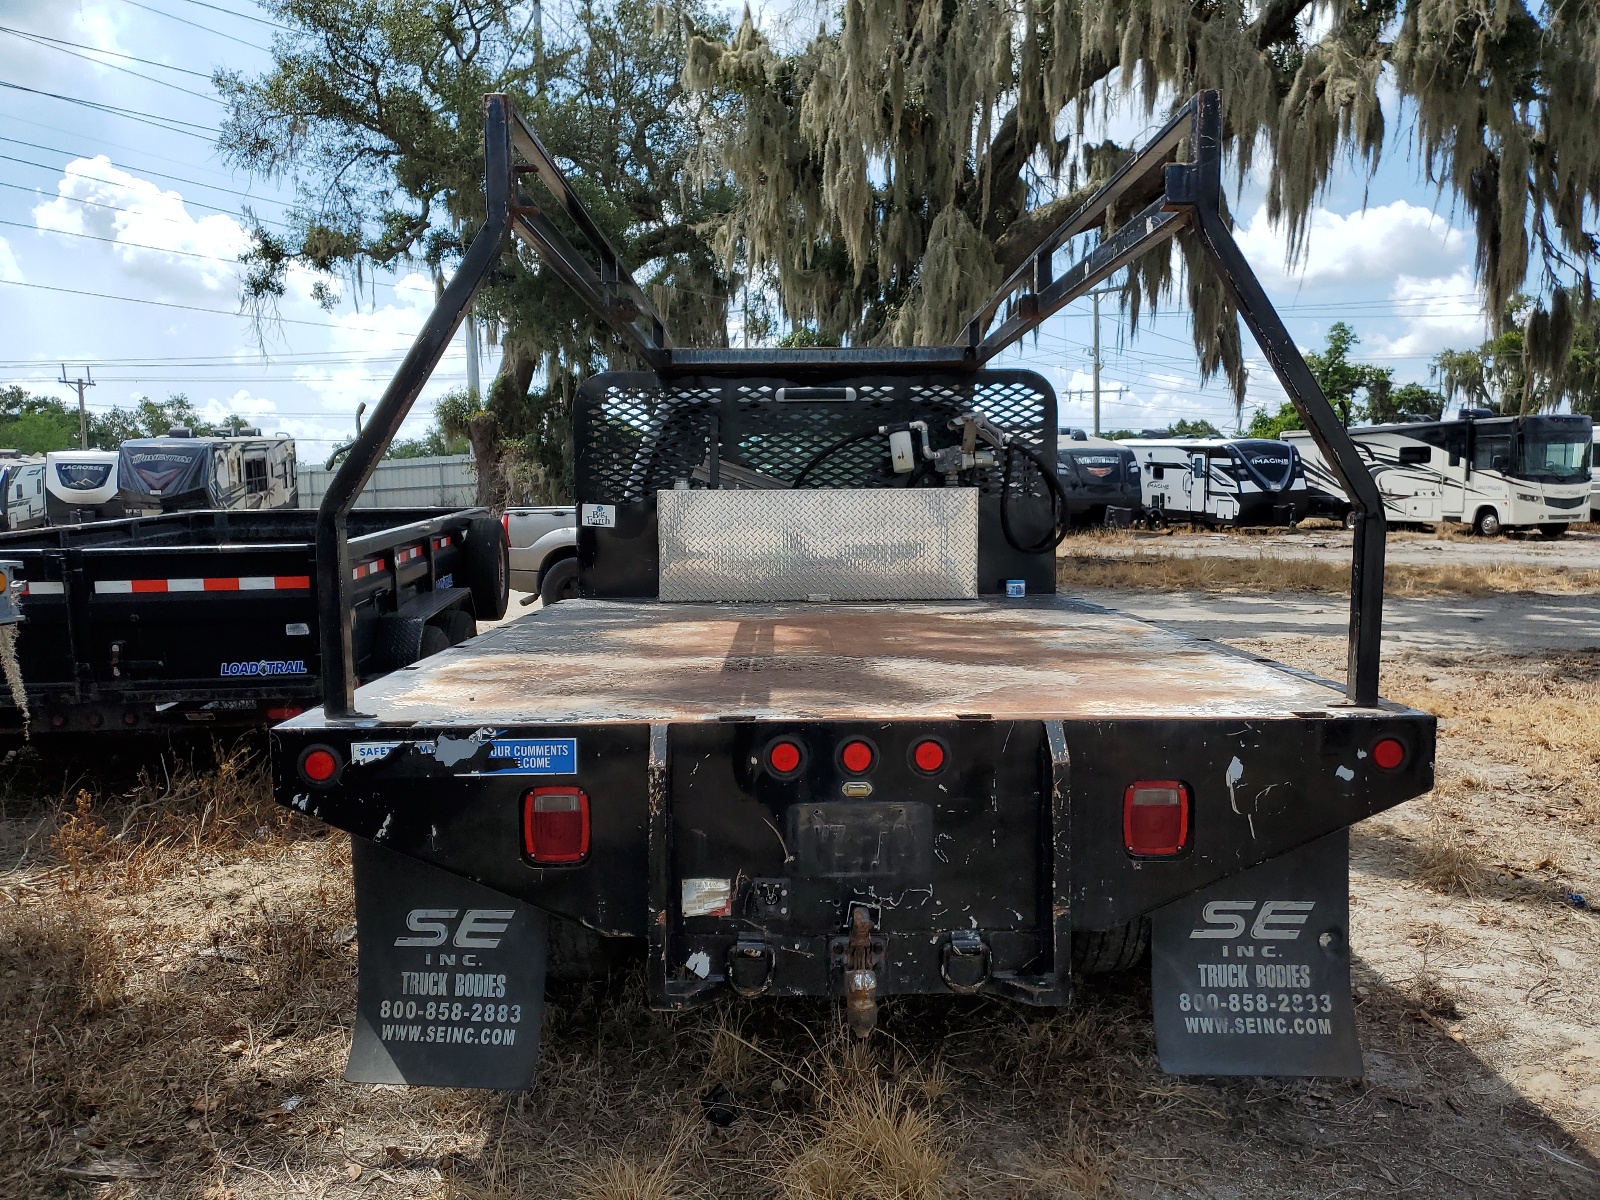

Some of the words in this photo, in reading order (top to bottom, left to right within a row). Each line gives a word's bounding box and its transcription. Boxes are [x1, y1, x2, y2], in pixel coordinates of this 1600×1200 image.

[61, 464, 105, 472] LACROSSE
[1252, 458, 1289, 466] IMAGINE
[592, 511, 606, 519] Big
[220, 661, 260, 676] LOAD
[266, 660, 308, 674] TRAIL
[359, 746, 394, 756] SAFET
[490, 745, 511, 757] OUR
[513, 745, 569, 757] COMMENTS
[1189, 900, 1316, 940] SE
[393, 909, 516, 949] SE
[1222, 945, 1283, 958] INC.
[425, 953, 483, 967] INC.
[401, 971, 448, 996] TRUCK
[454, 973, 506, 998] BODIES
[1197, 964, 1249, 988] TRUCK
[1255, 964, 1311, 989] BODIES
[380, 1000, 522, 1024] 800-858-2883
[1184, 1017, 1332, 1035] WWW.SEINC.COM
[381, 1024, 516, 1046] WWW.SEINC.COM
